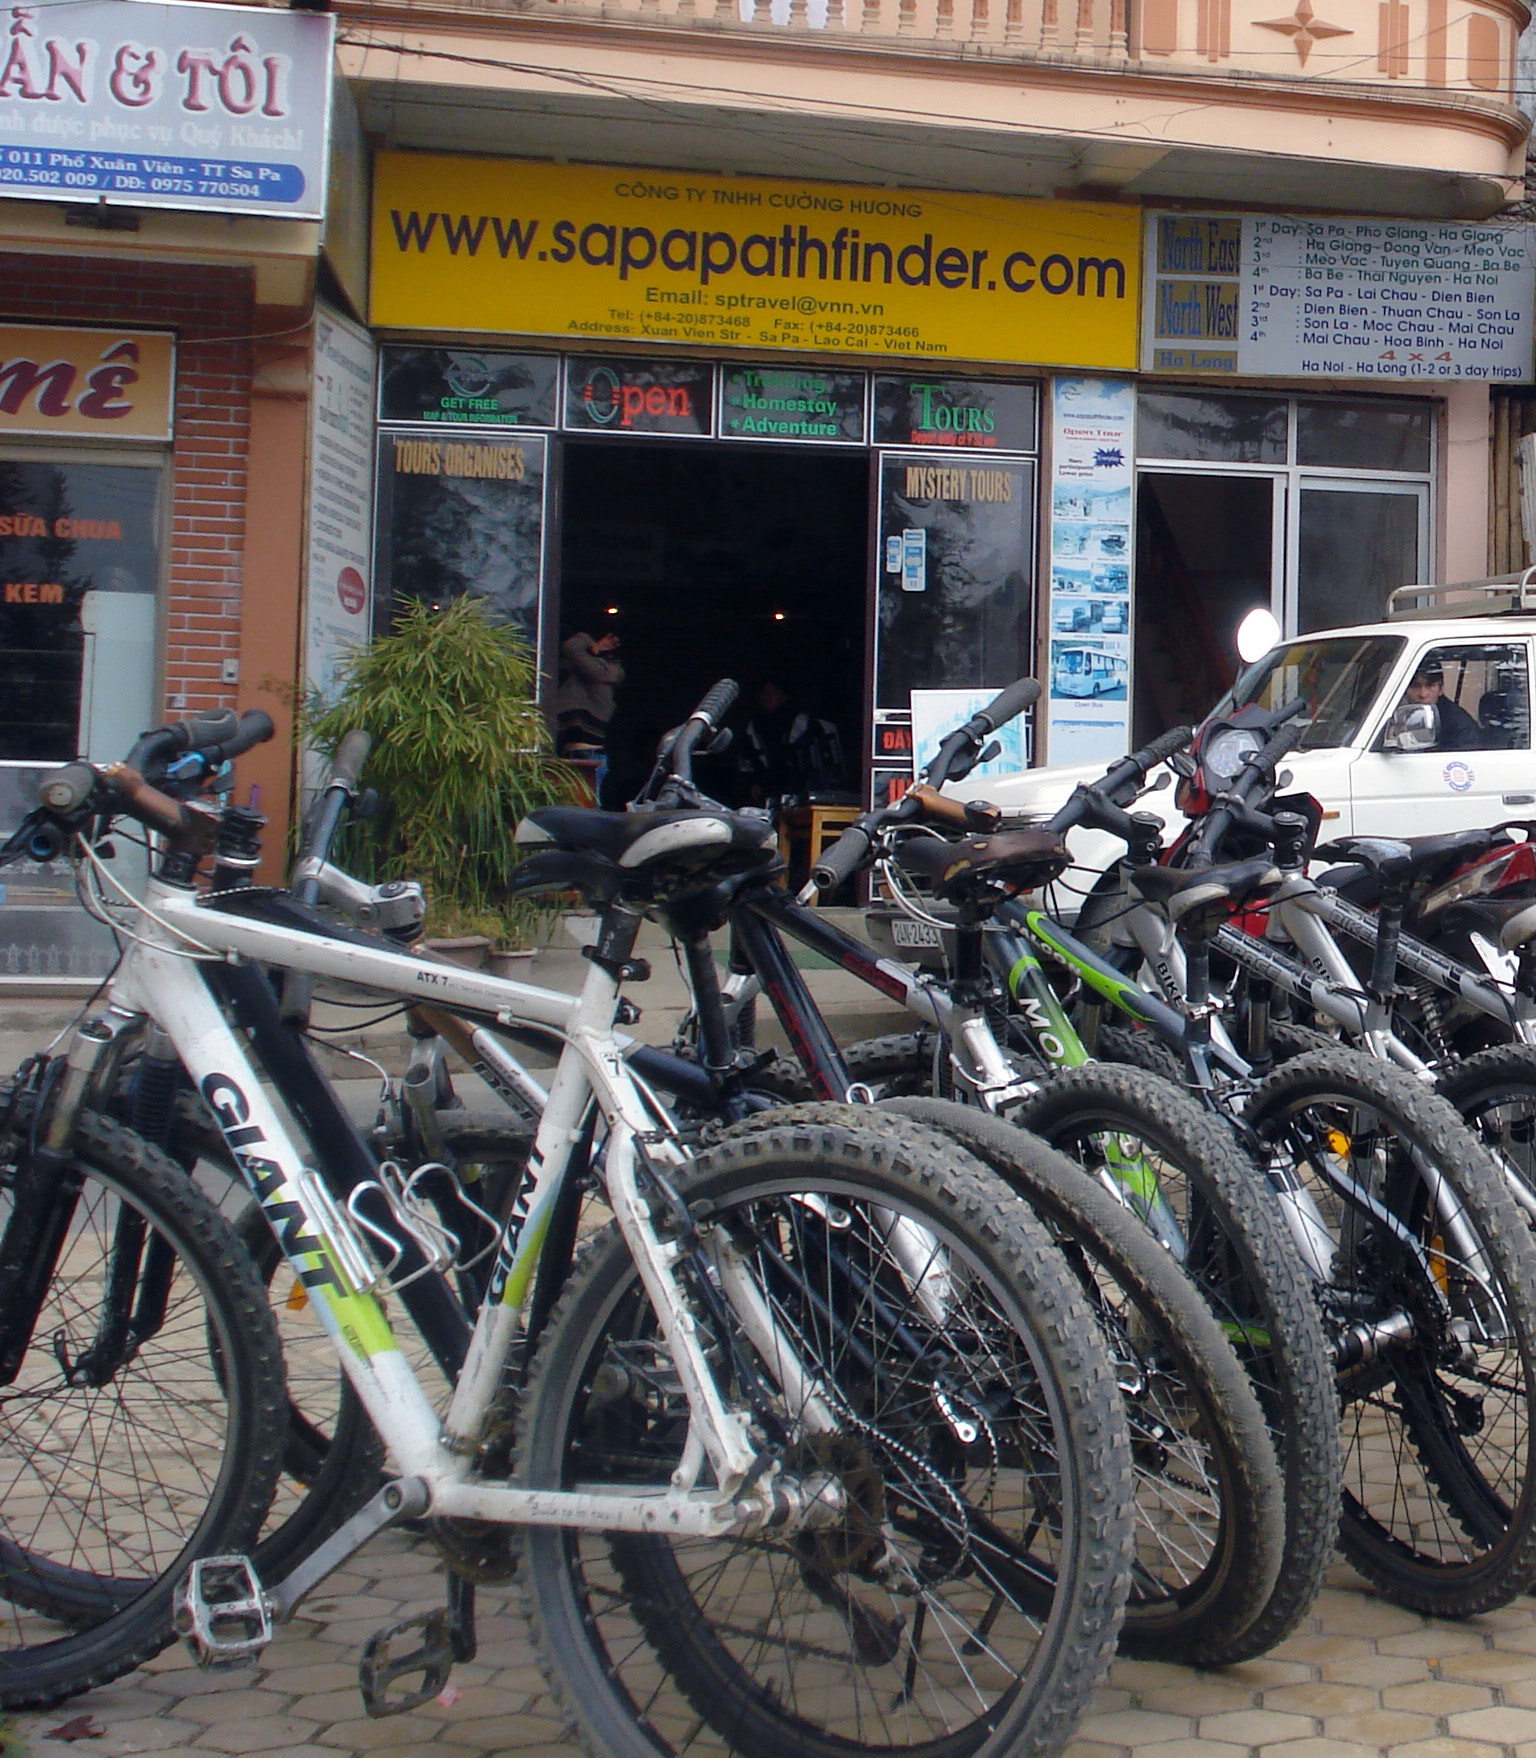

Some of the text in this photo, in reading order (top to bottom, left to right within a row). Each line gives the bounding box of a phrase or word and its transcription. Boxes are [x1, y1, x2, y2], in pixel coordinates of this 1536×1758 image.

[110, 36, 285, 117] & TÔI
[9, 151, 42, 165] 011
[49, 150, 85, 170] Phố
[90, 156, 138, 172] Xuân
[142, 159, 184, 175] Viên
[201, 163, 225, 178] TT
[229, 165, 253, 180] Sa
[259, 168, 282, 182] Pa
[64, 171, 98, 187] 009
[151, 177, 194, 193] 0975
[199, 181, 262, 198] 770504
[615, 180, 763, 207] CÔNG TY TNHH
[1307, 223, 1324, 235] Sa
[1385, 227, 1428, 242] Giang
[1438, 229, 1458, 240] Ha
[1462, 230, 1504, 244] Giang
[390, 207, 1127, 299] www.sapapathfinder.com
[1161, 219, 1241, 273] North East
[1306, 239, 1325, 251] Ha
[1329, 240, 1372, 254] Giang
[1383, 241, 1420, 256] Dong
[1425, 243, 1451, 255] Van
[1498, 246, 1525, 258] Vac
[1305, 253, 1337, 265] Meo
[1341, 254, 1368, 266] Vac
[1380, 257, 1419, 271] Tuyen
[1424, 258, 1471, 272] Quang
[1483, 260, 1500, 271] Ba
[1504, 260, 1521, 272] Be
[1305, 268, 1323, 280] Ba
[1327, 269, 1344, 281] Be
[1357, 271, 1385, 282] Thai
[1389, 272, 1442, 286] Nguyen
[1453, 274, 1472, 285] Ha
[1476, 275, 1499, 286] Noi
[645, 287, 884, 316] Email: sptravel@vnn.vn
[1270, 286, 1301, 299] Day:
[1305, 286, 1322, 298] Sa
[1326, 287, 1344, 298] Pa
[1357, 288, 1377, 300] Lai
[1381, 289, 1418, 301] Chau
[1431, 290, 1462, 302] Dien
[1466, 292, 1495, 304] Bien
[608, 309, 751, 328] Tel: (+84-20)873468
[1160, 284, 1238, 338] North West
[1304, 303, 1335, 315] Dien
[1339, 304, 1368, 316] Bien
[1381, 306, 1422, 318] Thuan
[1426, 307, 1463, 319] Chau
[1476, 308, 1501, 320] Son
[1505, 309, 1520, 321] La
[567, 319, 636, 335] Address:
[640, 323, 676, 337] Xuan
[719, 329, 742, 340] Str
[759, 331, 778, 343] Sa
[782, 332, 801, 344] Pa
[814, 334, 840, 346] Lao
[846, 335, 869, 347] Cai
[884, 339, 911, 351] Viet
[915, 341, 948, 352] Nam
[774, 318, 920, 338] Fax: (+84-20)873466
[1304, 318, 1329, 330] Son
[1333, 319, 1349, 330] La
[1363, 320, 1392, 332] Moc
[1397, 321, 1435, 333] Chau
[1448, 322, 1473, 334] Mai
[1477, 323, 1514, 335] Chau
[1303, 333, 1328, 345] Mai
[1333, 334, 1370, 346] Chau
[1384, 335, 1412, 347] Hoa
[1416, 336, 1444, 348] Binh
[1458, 337, 1477, 349] Ha
[1481, 338, 1504, 349] Noi
[1160, 352, 1234, 372] Ha Long
[1378, 350, 1397, 361] 4
[1434, 351, 1453, 362] 4
[1302, 360, 1522, 379] Ha Noi Ha Long (1-2 or 3 day trips)
[440, 397, 499, 411] GET FREE
[584, 366, 691, 427] Open
[741, 393, 838, 416] Homestay
[741, 416, 838, 437] Adventure
[395, 440, 441, 476] TOURS
[905, 466, 1013, 502] MYSTERY TOURS
[4, 583, 65, 604] KEM
[416, 971, 449, 987] ATX 7
[1156, 962, 1183, 1009] BIKE
[200, 1073, 348, 1298] GIANT
[488, 1143, 545, 1308] GIANT
